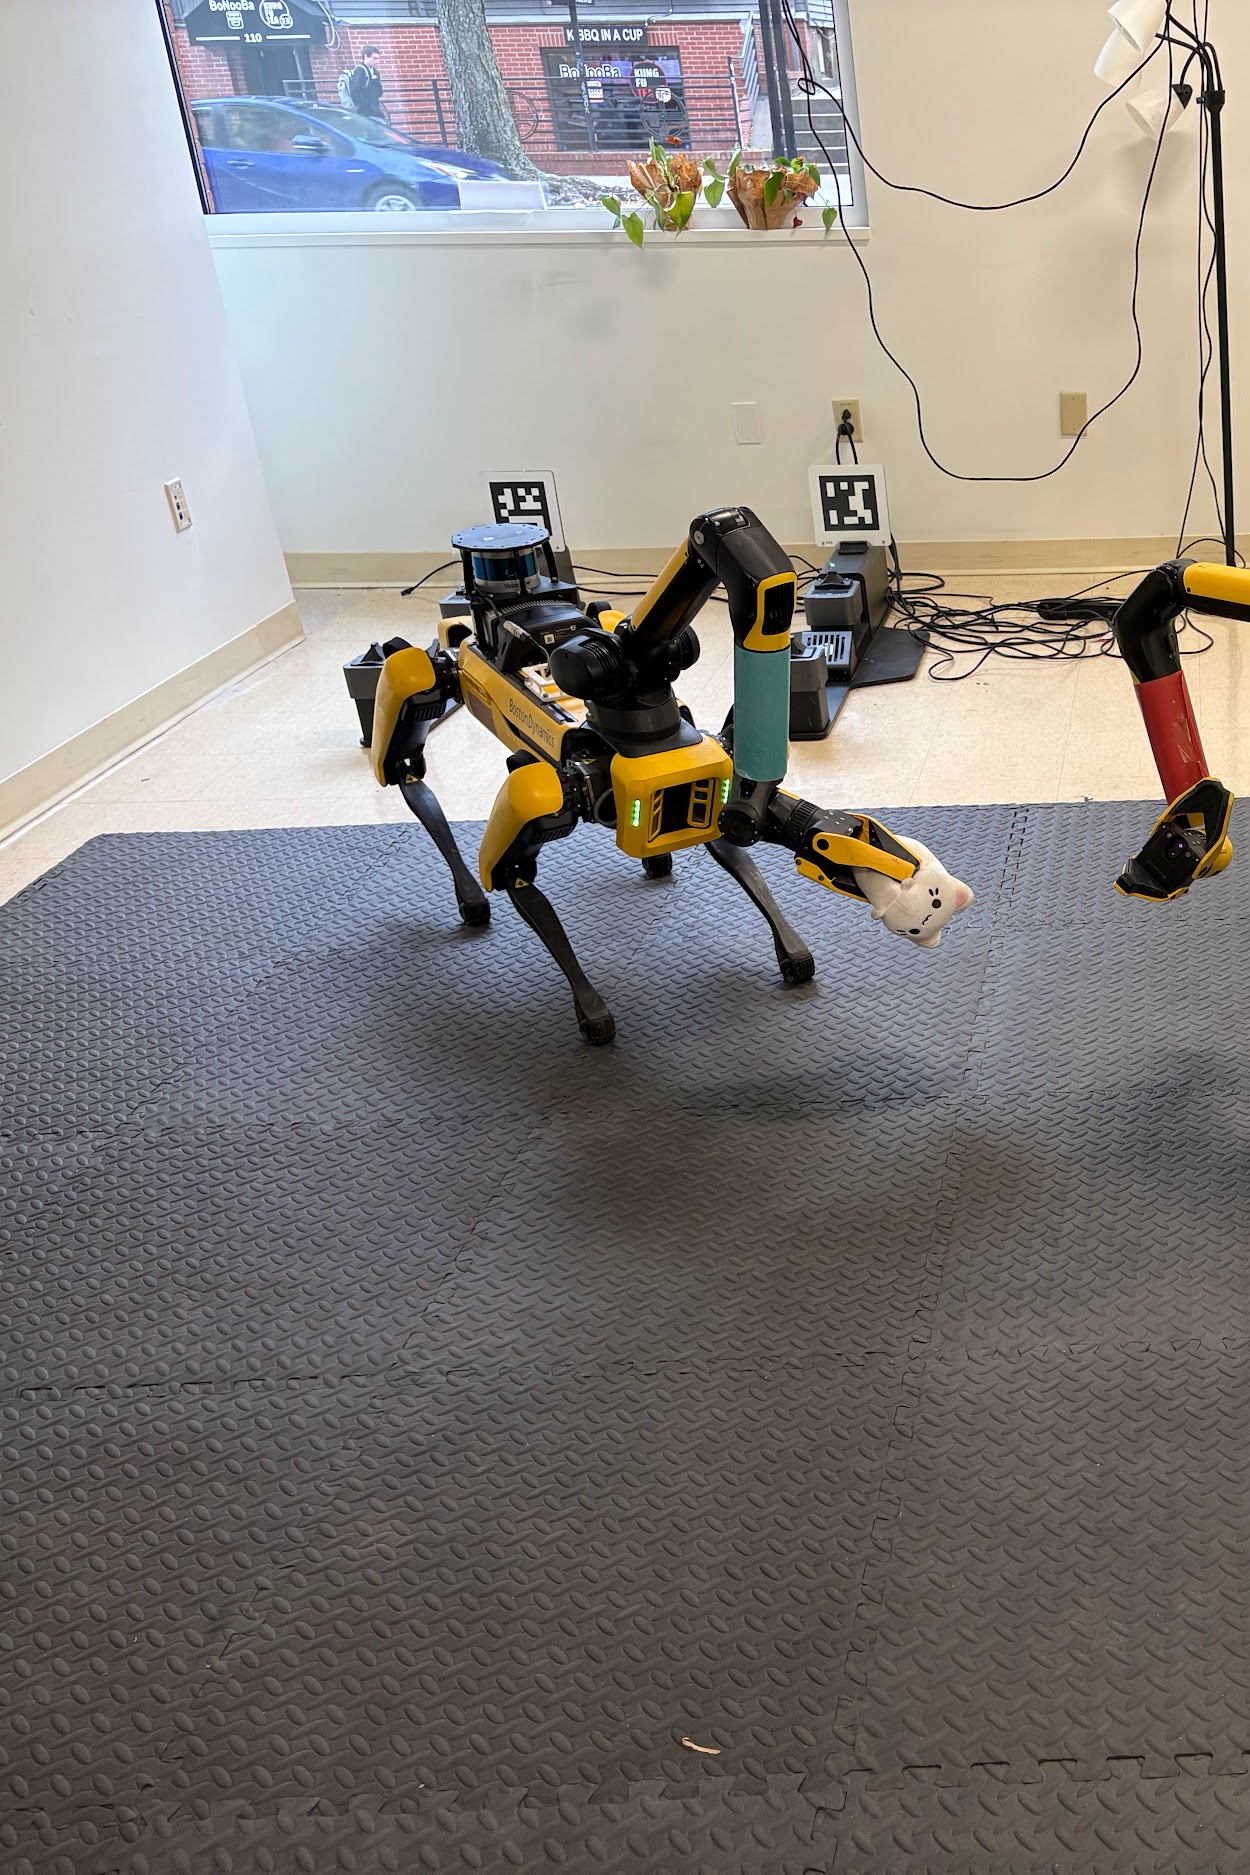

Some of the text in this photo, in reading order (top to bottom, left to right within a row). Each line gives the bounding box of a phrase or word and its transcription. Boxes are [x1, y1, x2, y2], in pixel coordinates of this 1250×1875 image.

[243, 33, 263, 43] 110
[600, 28, 611, 42] IN
[613, 28, 621, 42] A
[622, 28, 643, 42] CUP
[634, 67, 660, 78] KUNG
[635, 77, 648, 88] FU
